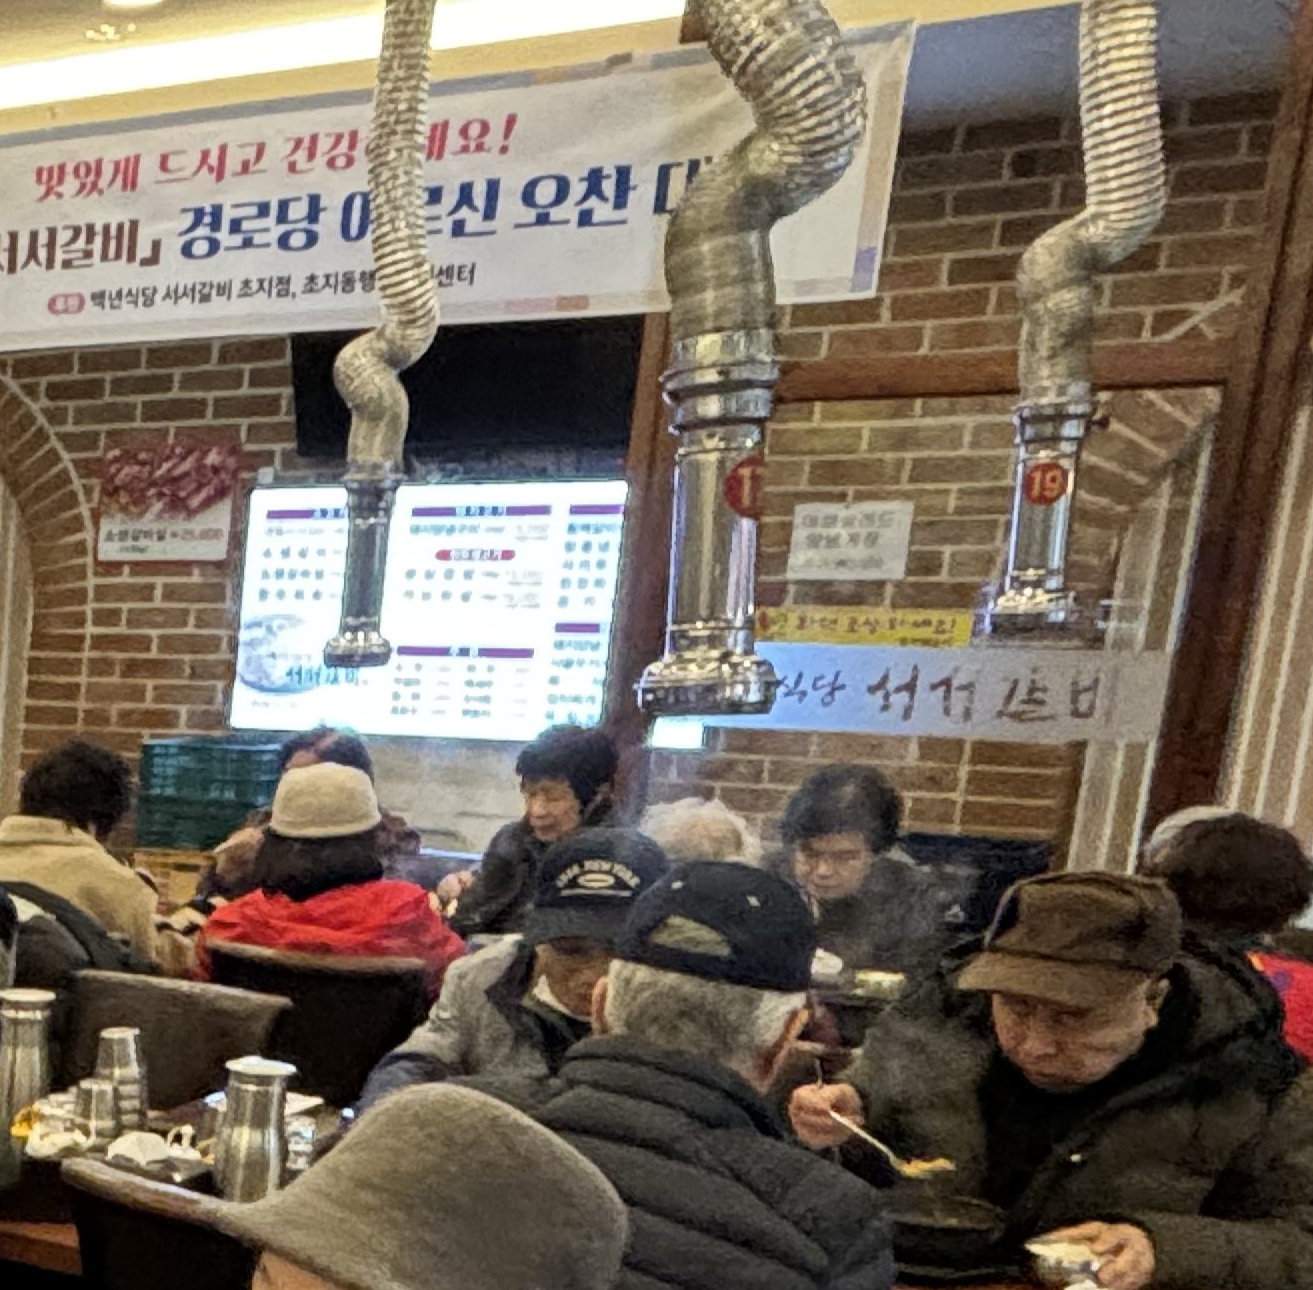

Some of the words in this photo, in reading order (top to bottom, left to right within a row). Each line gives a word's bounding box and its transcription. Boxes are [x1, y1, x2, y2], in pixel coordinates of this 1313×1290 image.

[34, 153, 142, 202] 맛있게
[155, 141, 268, 184] 드시고
[283, 113, 518, 175] 건강세요!
[178, 193, 328, 260] 경로당
[513, 165, 639, 228] 오찬
[90, 285, 159, 311] 백년식당
[162, 279, 234, 305] 서서갈비
[237, 274, 297, 301] 초지점,
[1029, 468, 1063, 498] 19
